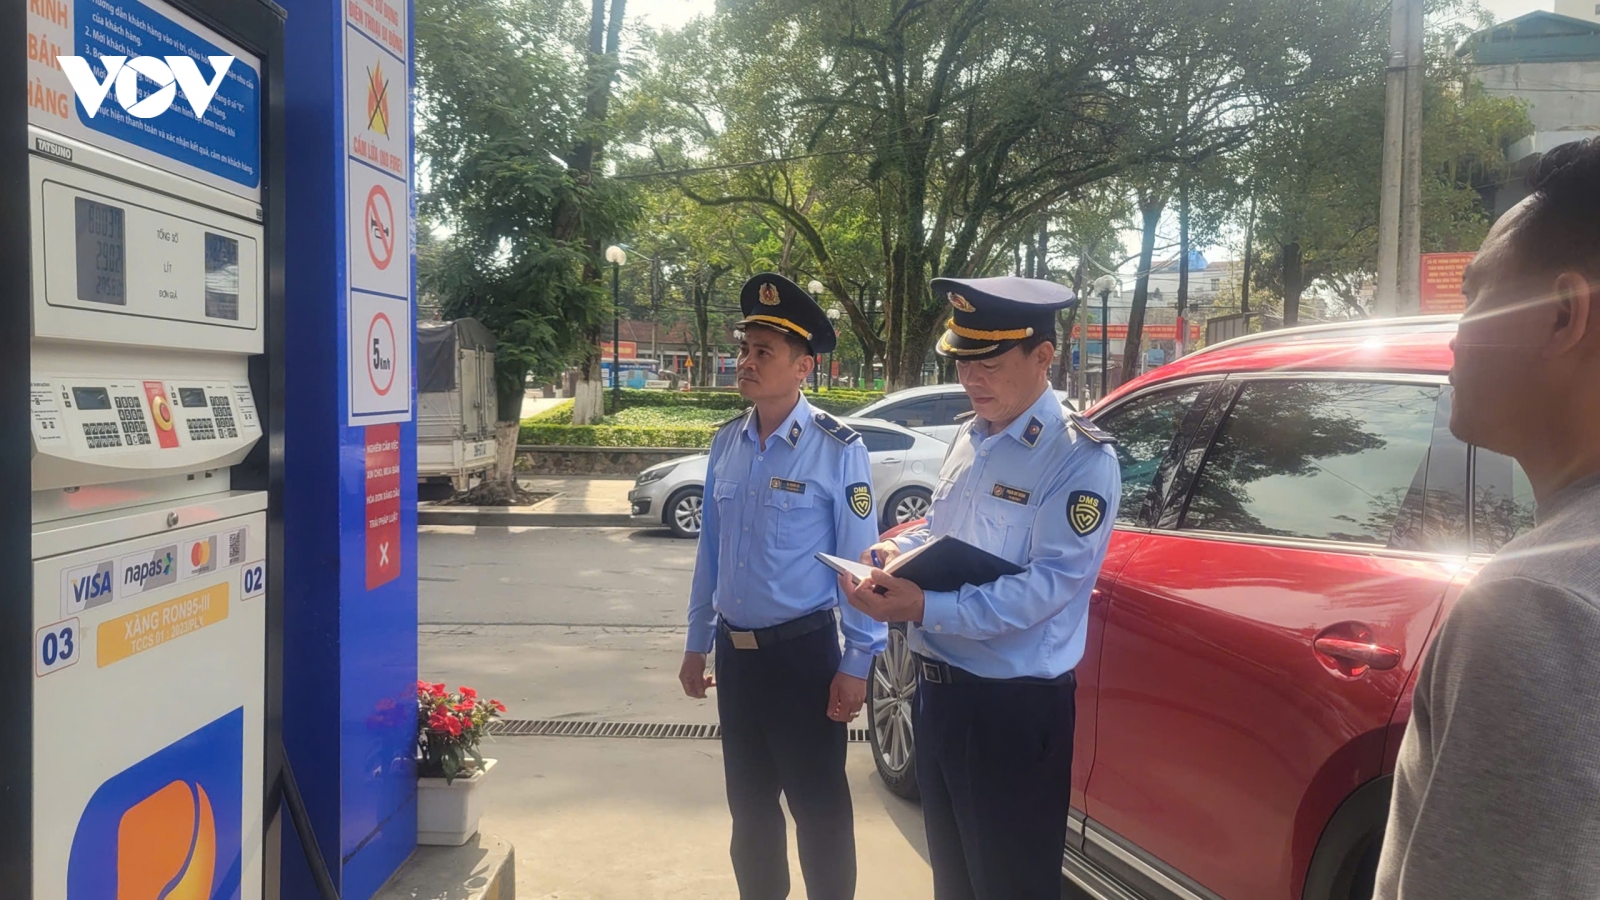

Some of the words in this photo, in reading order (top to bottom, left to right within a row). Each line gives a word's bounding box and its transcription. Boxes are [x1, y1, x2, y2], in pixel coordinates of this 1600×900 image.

[85, 26, 92, 37] 2.
[105, 17, 124, 36] khách
[28, 33, 61, 71] BÁN
[85, 44, 92, 55] 3.
[38, 139, 71, 159] TATSUNO
[373, 338, 380, 370] 5
[1078, 495, 1099, 506] DMS
[71, 570, 111, 602] VISA
[124, 558, 163, 586] napas
[244, 566, 262, 594] 02
[124, 611, 159, 640] XĂNG
[162, 593, 210, 626] RON95-III
[42, 627, 74, 666] 03
[131, 634, 154, 653] TCCS
[156, 630, 164, 643] 01
